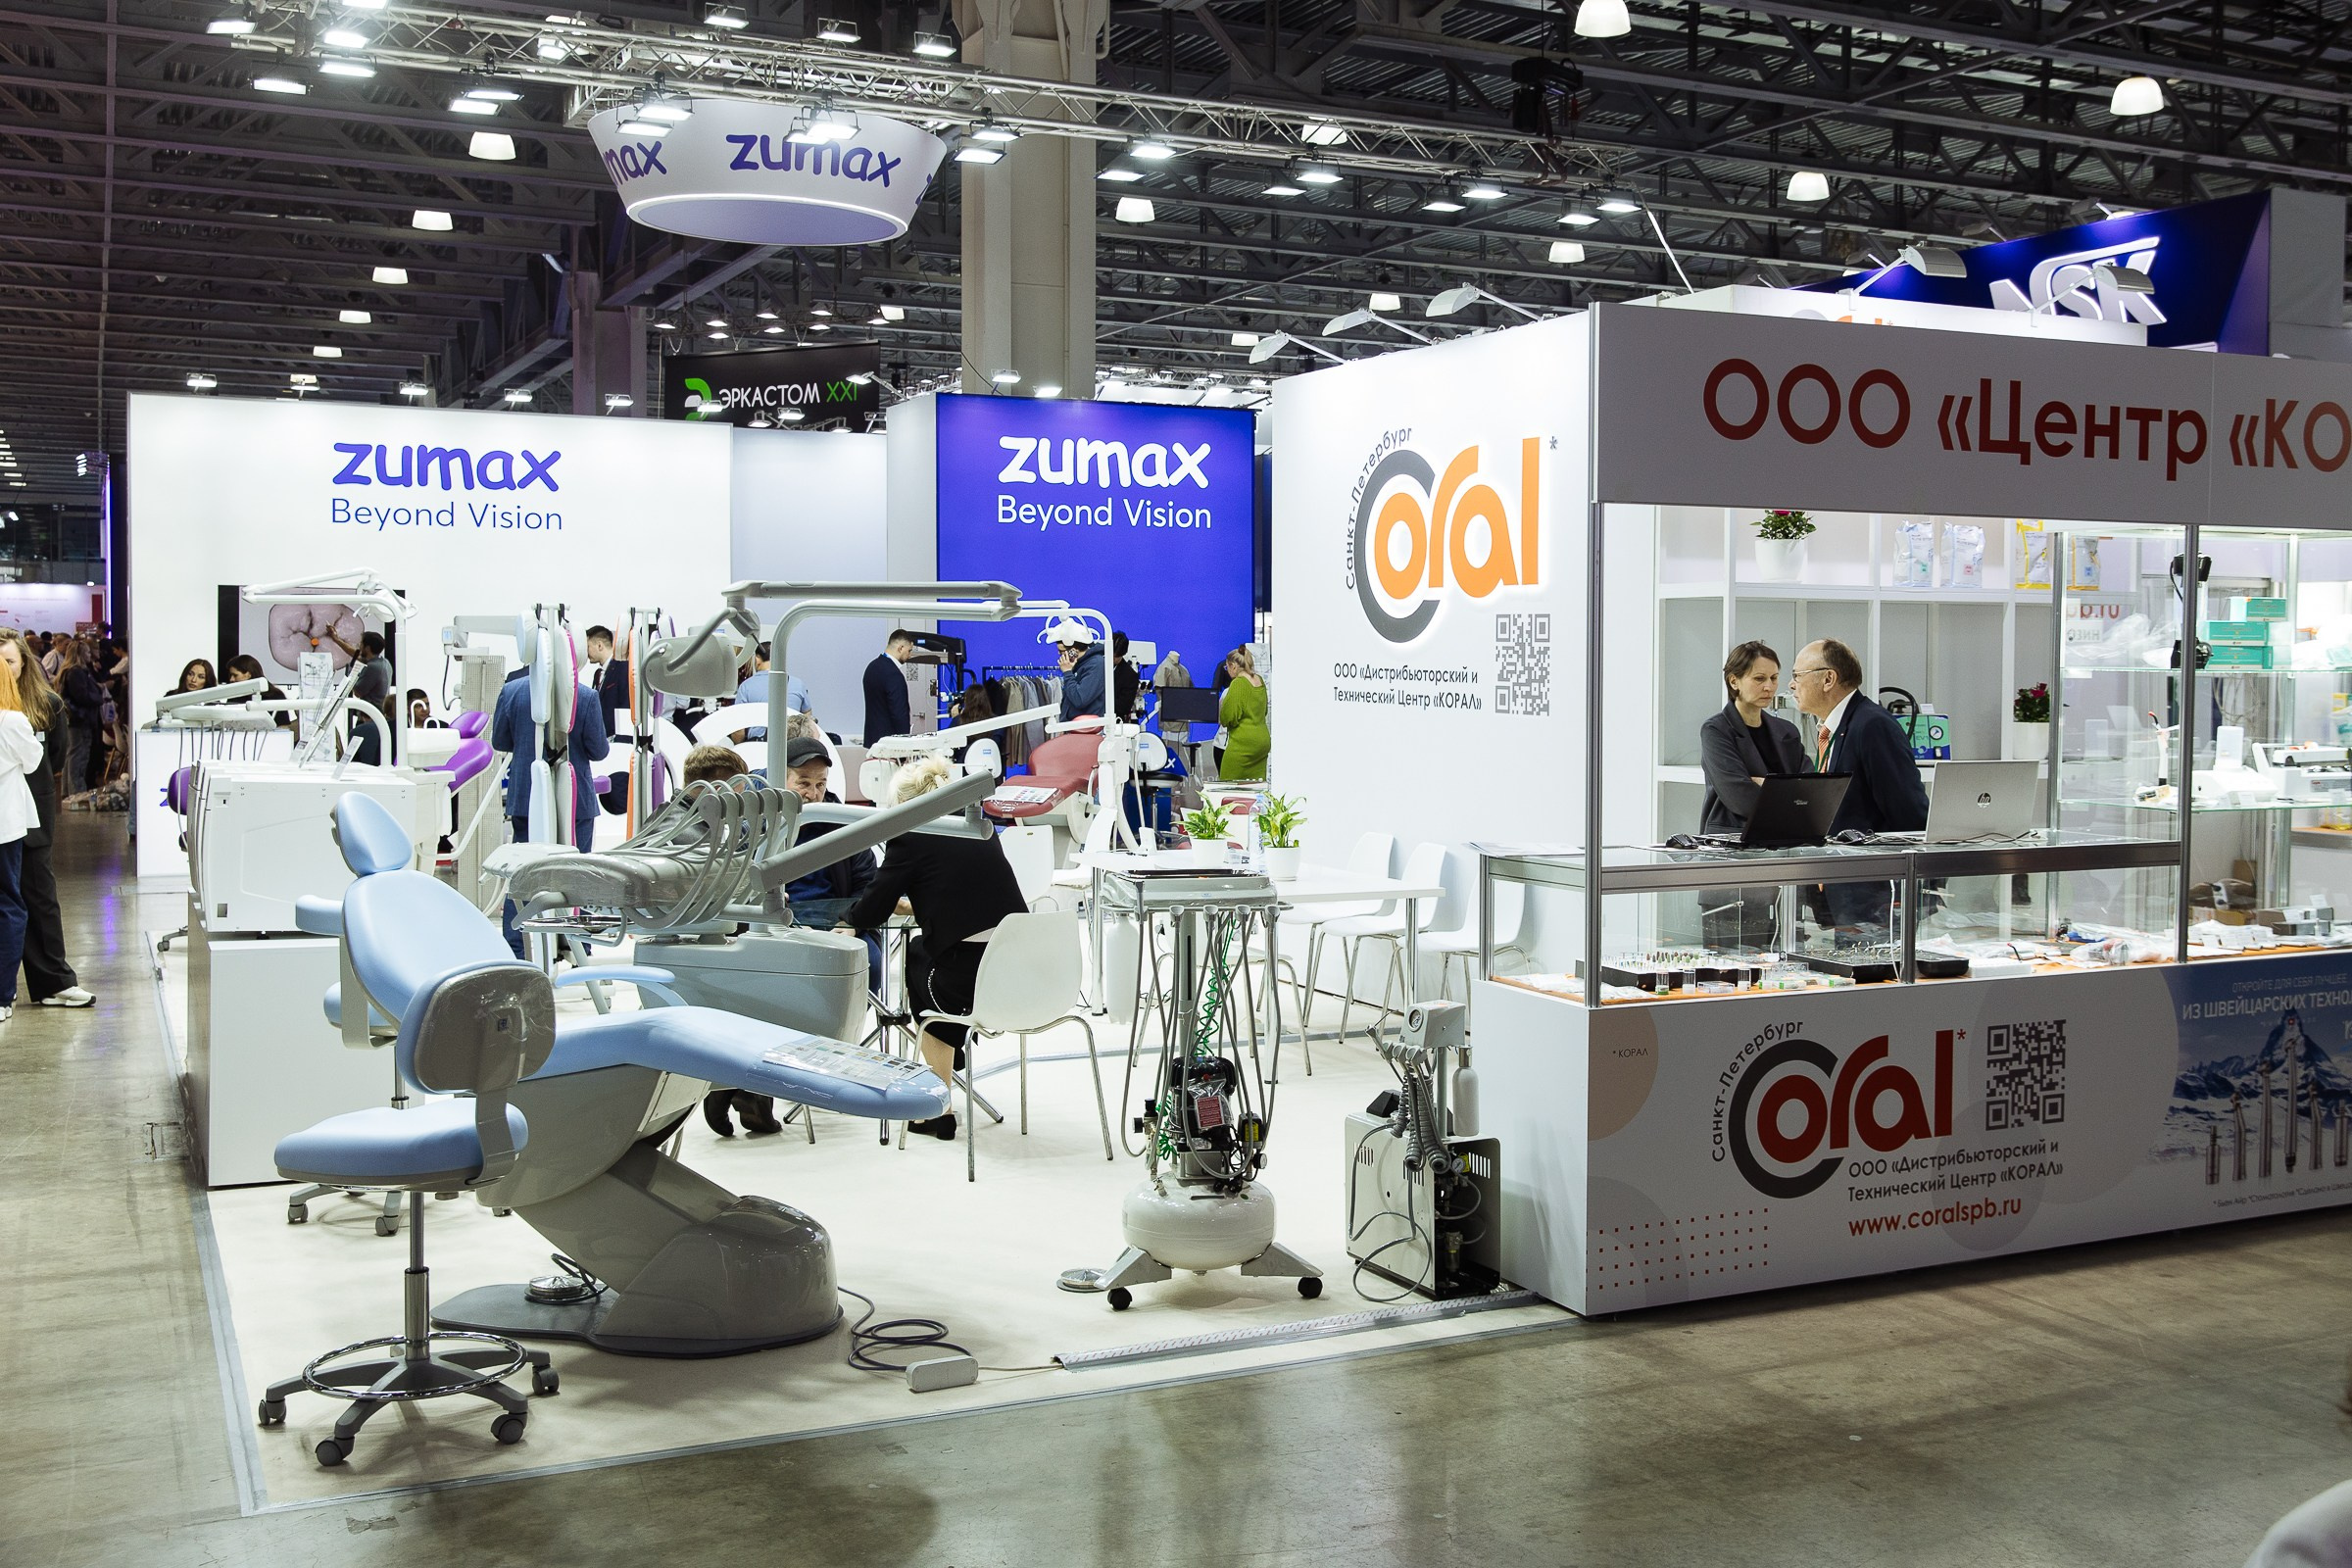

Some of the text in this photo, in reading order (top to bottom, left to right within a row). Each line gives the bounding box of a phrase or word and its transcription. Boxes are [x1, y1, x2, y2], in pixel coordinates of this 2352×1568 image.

[726, 133, 902, 188] zumax
[718, 381, 820, 410] ЭРКАСТОМ
[1703, 358, 1911, 449] ООО
[1937, 378, 2207, 481] «Центр
[332, 442, 563, 493] zumax
[998, 435, 1211, 489] zumax
[331, 497, 564, 532] Beyond Vision
[998, 494, 1212, 532] Beyond Vision
[1346, 427, 1412, 591] Санкт-Петербург
[1334, 662, 1478, 685] ООО «Дистрибьюторский и
[1334, 686, 1482, 710] Технический Центр «КОРАЛ»
[2274, 978, 2292, 991] ДЛЯ
[2293, 975, 2313, 988] СЕБЯ
[2182, 1004, 2201, 1020] ИЗ
[2204, 994, 2306, 1018] ШВЕЙЦАРСКИХ
[1712, 1020, 1804, 1162] Санкт-Петербург
[1849, 1143, 2059, 1178] ООО «Дистрибьюторский и
[1848, 1162, 2064, 1202] Технический Центр «КОРАЛ»
[1848, 1197, 2022, 1237] www.coralspb.ru
